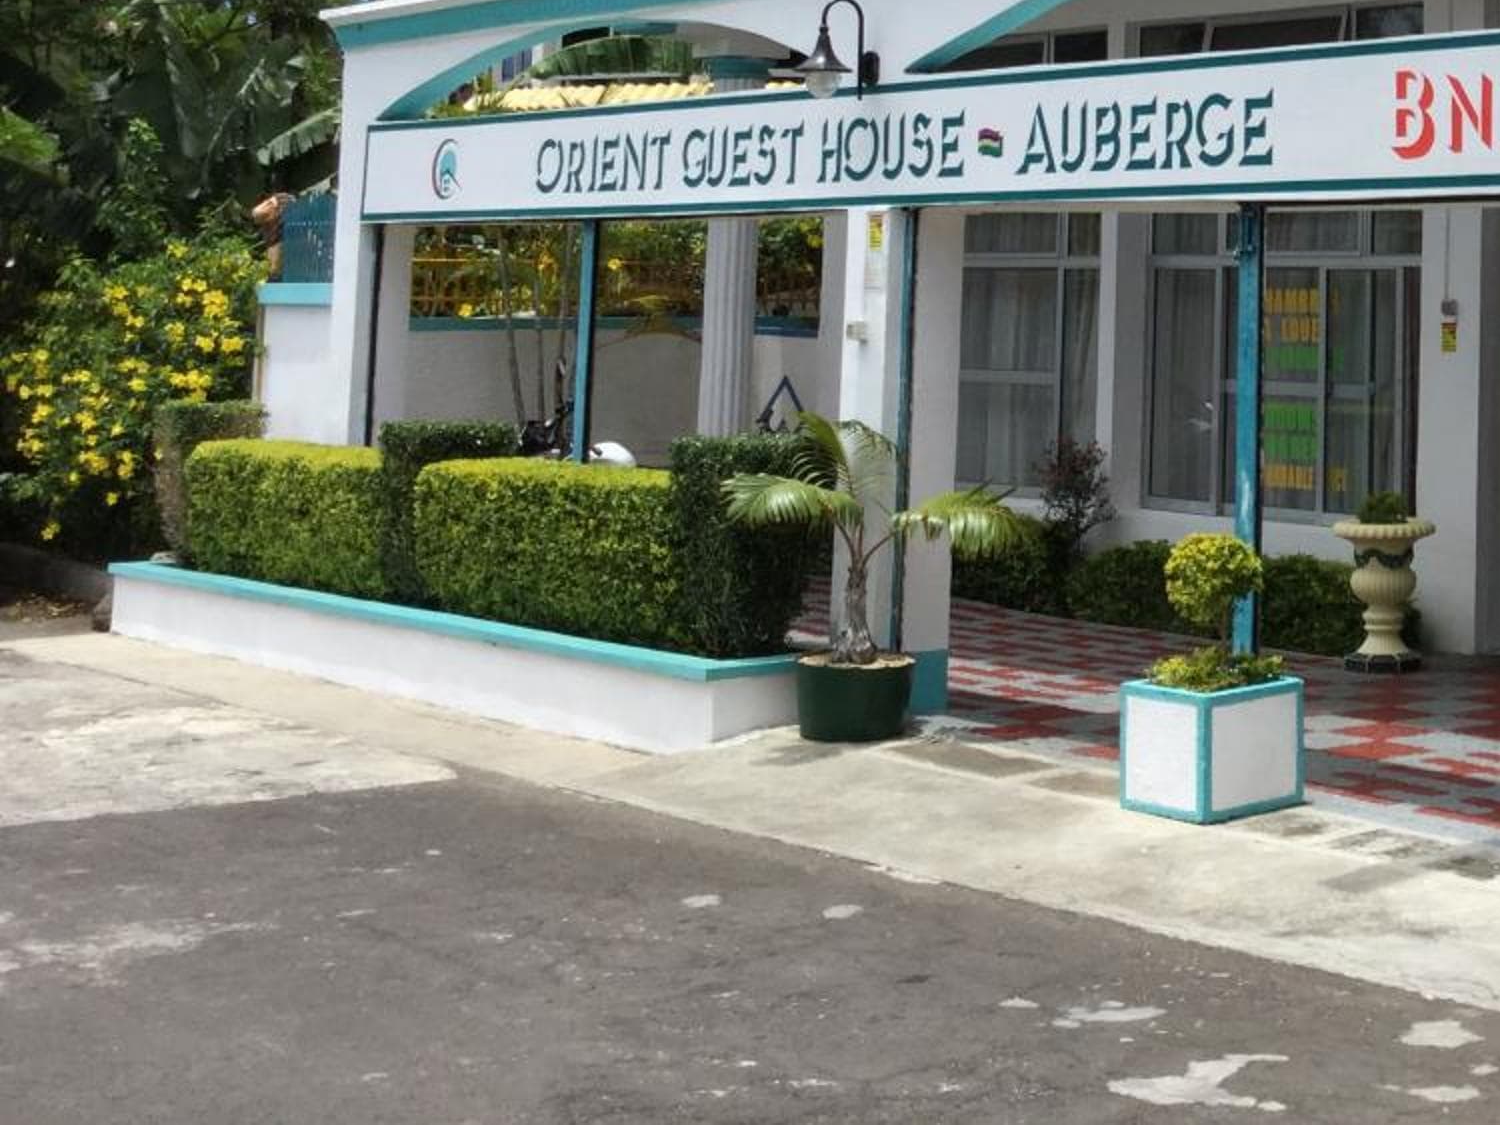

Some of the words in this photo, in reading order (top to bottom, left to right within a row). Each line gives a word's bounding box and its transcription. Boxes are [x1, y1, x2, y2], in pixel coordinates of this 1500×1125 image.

[536, 129, 672, 194] ORIENT
[682, 119, 805, 188] GUEST
[817, 107, 966, 183] HOUSE
[1015, 87, 1275, 176] AUBERGE
